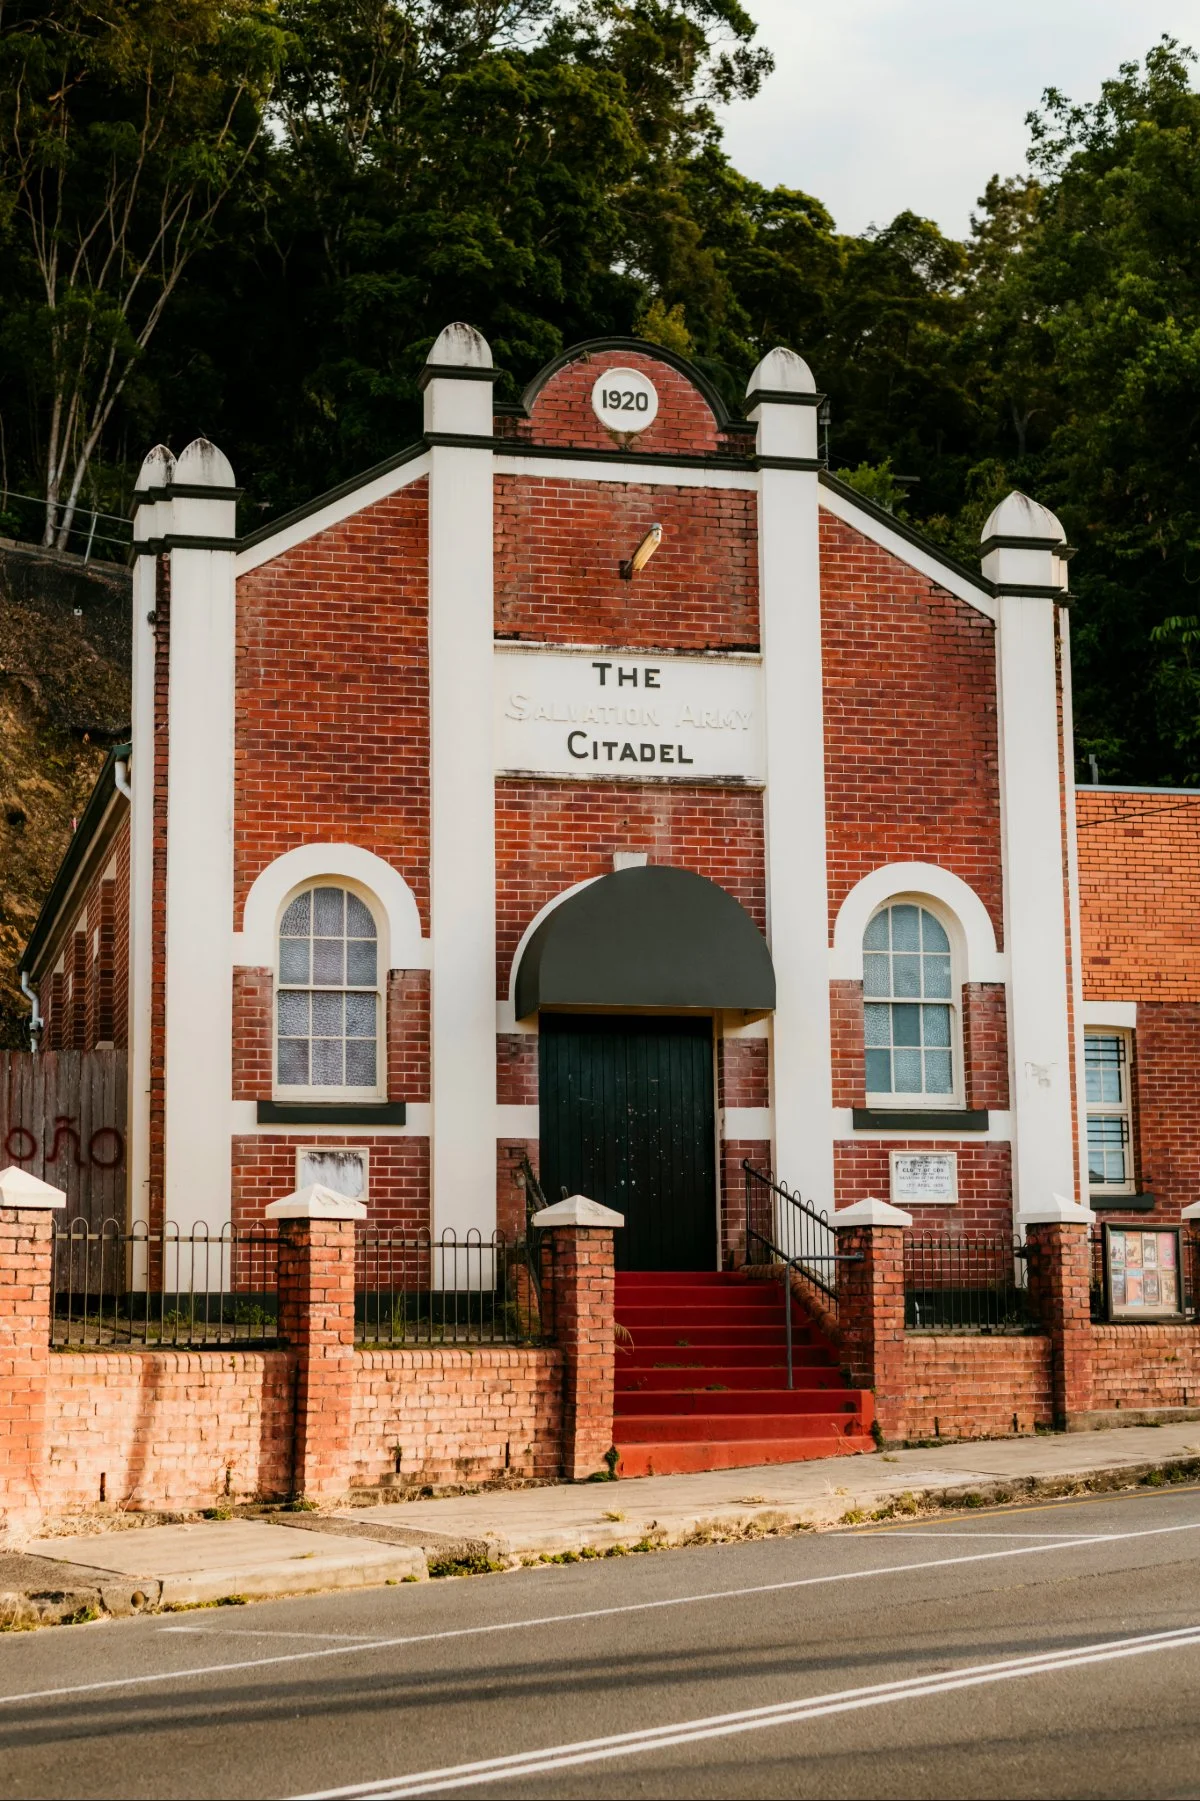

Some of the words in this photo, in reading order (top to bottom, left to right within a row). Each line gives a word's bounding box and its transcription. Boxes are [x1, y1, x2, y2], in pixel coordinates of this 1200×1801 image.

[602, 389, 649, 412] 1920
[592, 662, 661, 689] THE
[504, 691, 660, 727] SALVATION
[675, 702, 754, 730] ARMY
[567, 730, 694, 764] CITADEL
